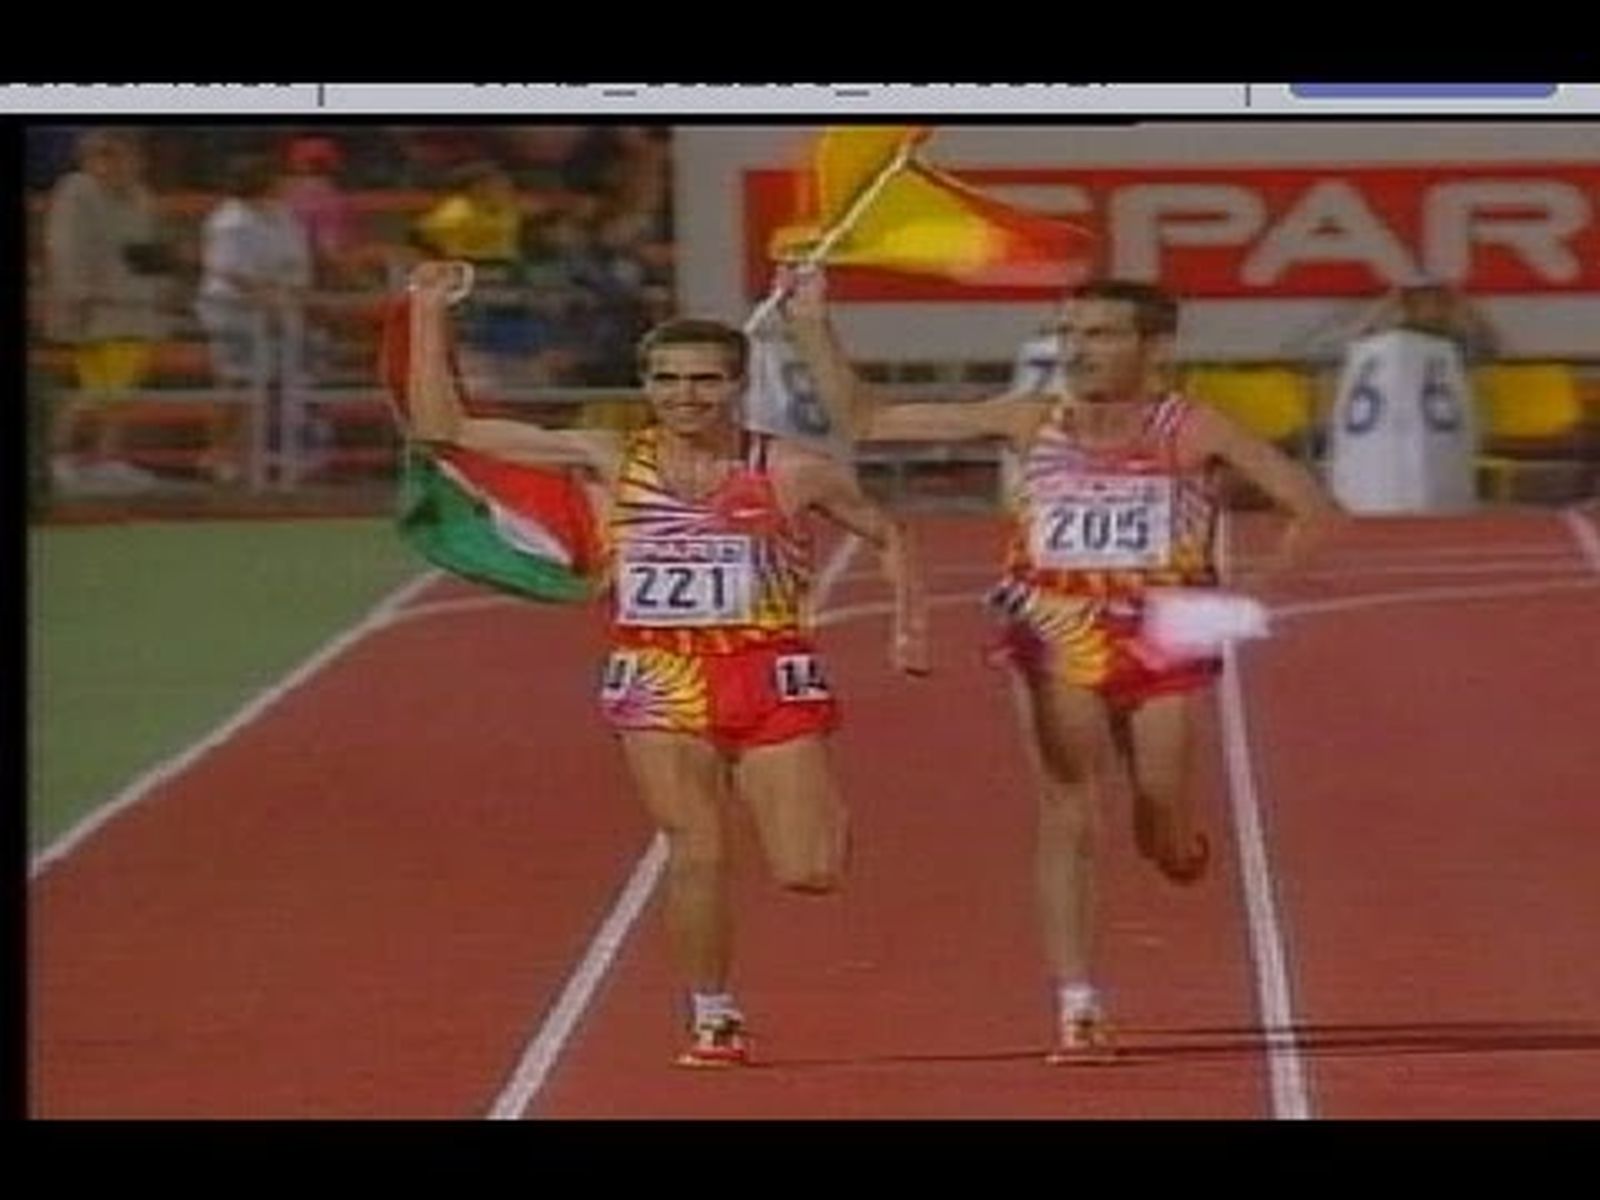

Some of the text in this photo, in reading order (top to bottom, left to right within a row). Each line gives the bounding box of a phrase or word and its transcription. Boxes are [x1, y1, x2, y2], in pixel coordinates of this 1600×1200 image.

[1344, 356, 1384, 435] 6
[1047, 505, 1150, 552] 205
[629, 565, 727, 611] 221
